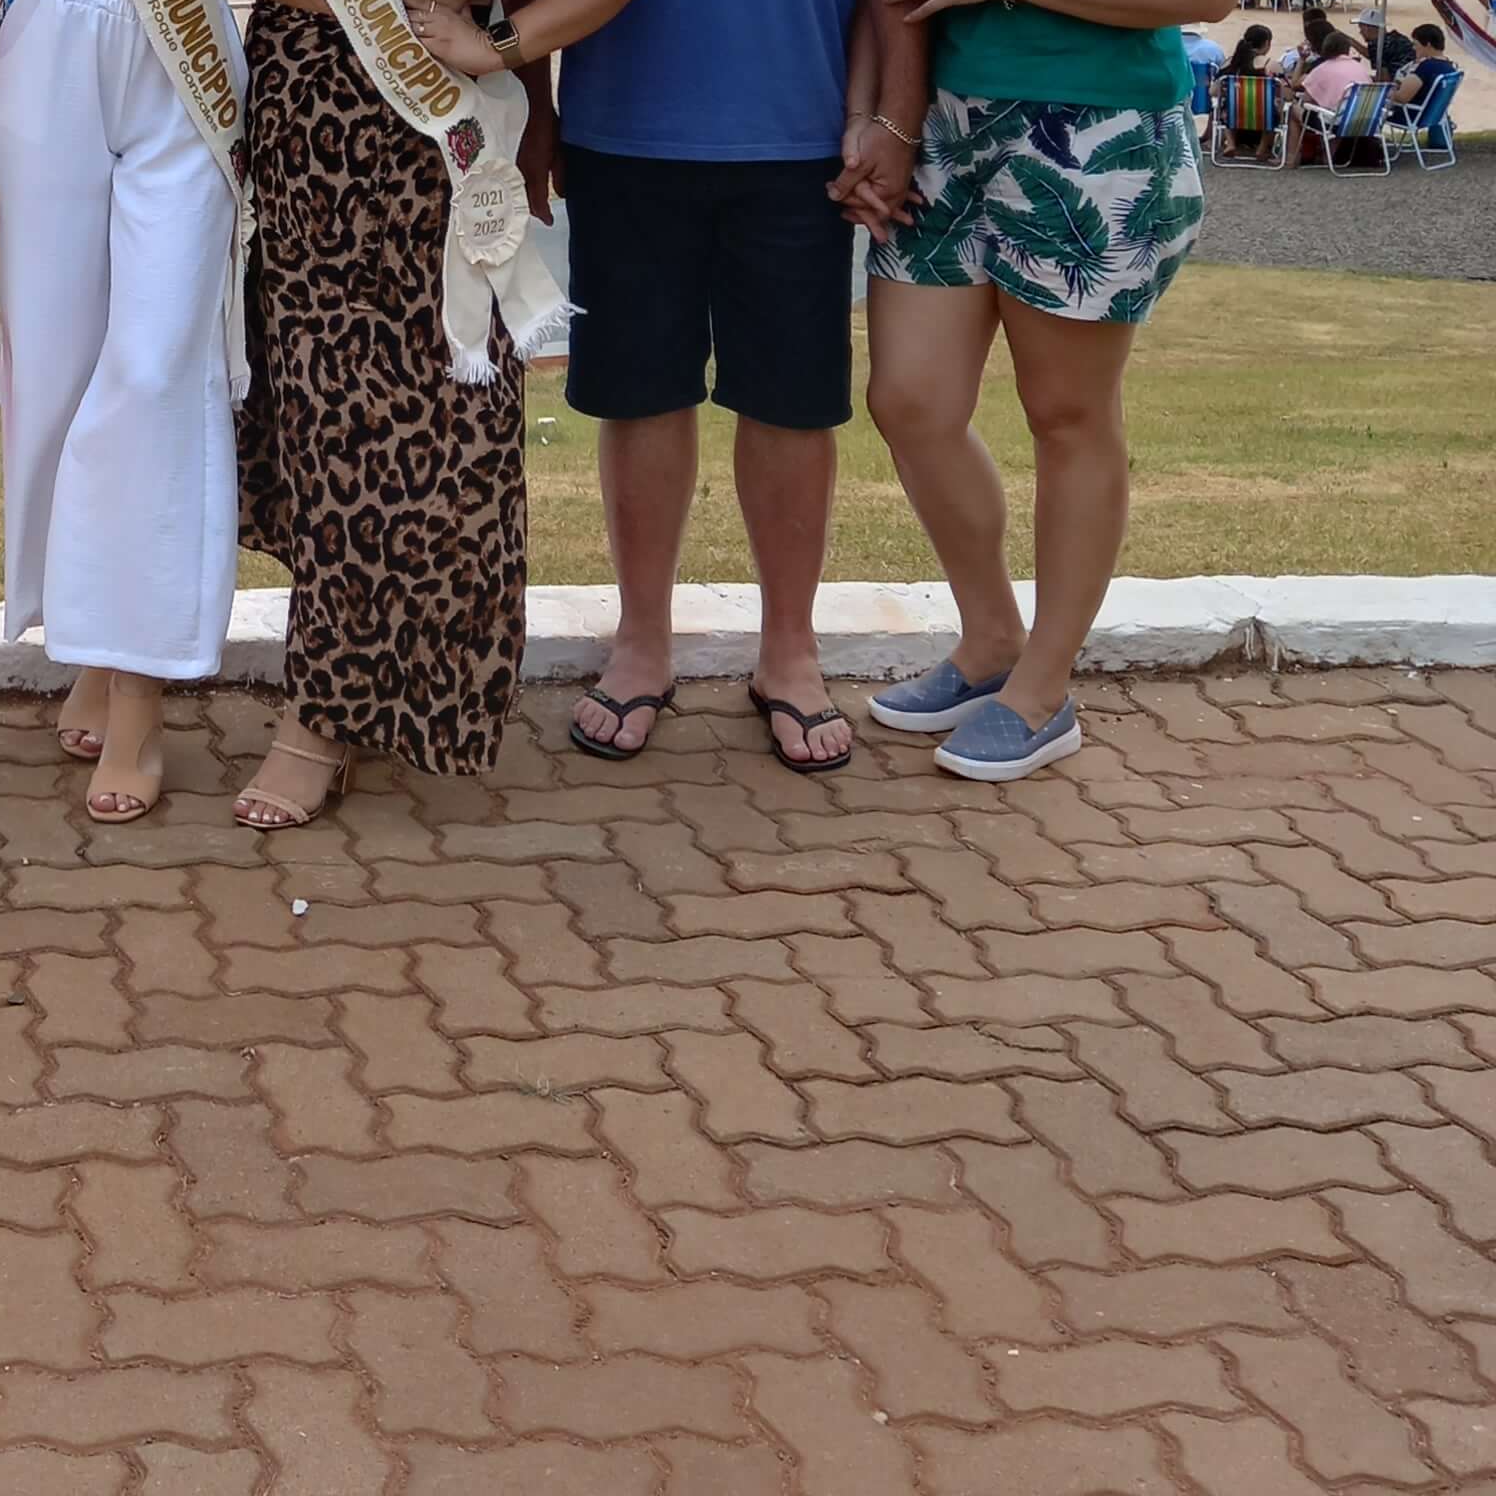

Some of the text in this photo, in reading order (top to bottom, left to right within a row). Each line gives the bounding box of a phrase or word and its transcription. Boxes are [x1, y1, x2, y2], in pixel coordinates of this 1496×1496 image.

[375, 56, 430, 125] Gonzales
[471, 189, 504, 208] 2021
[473, 218, 505, 237] 2022
